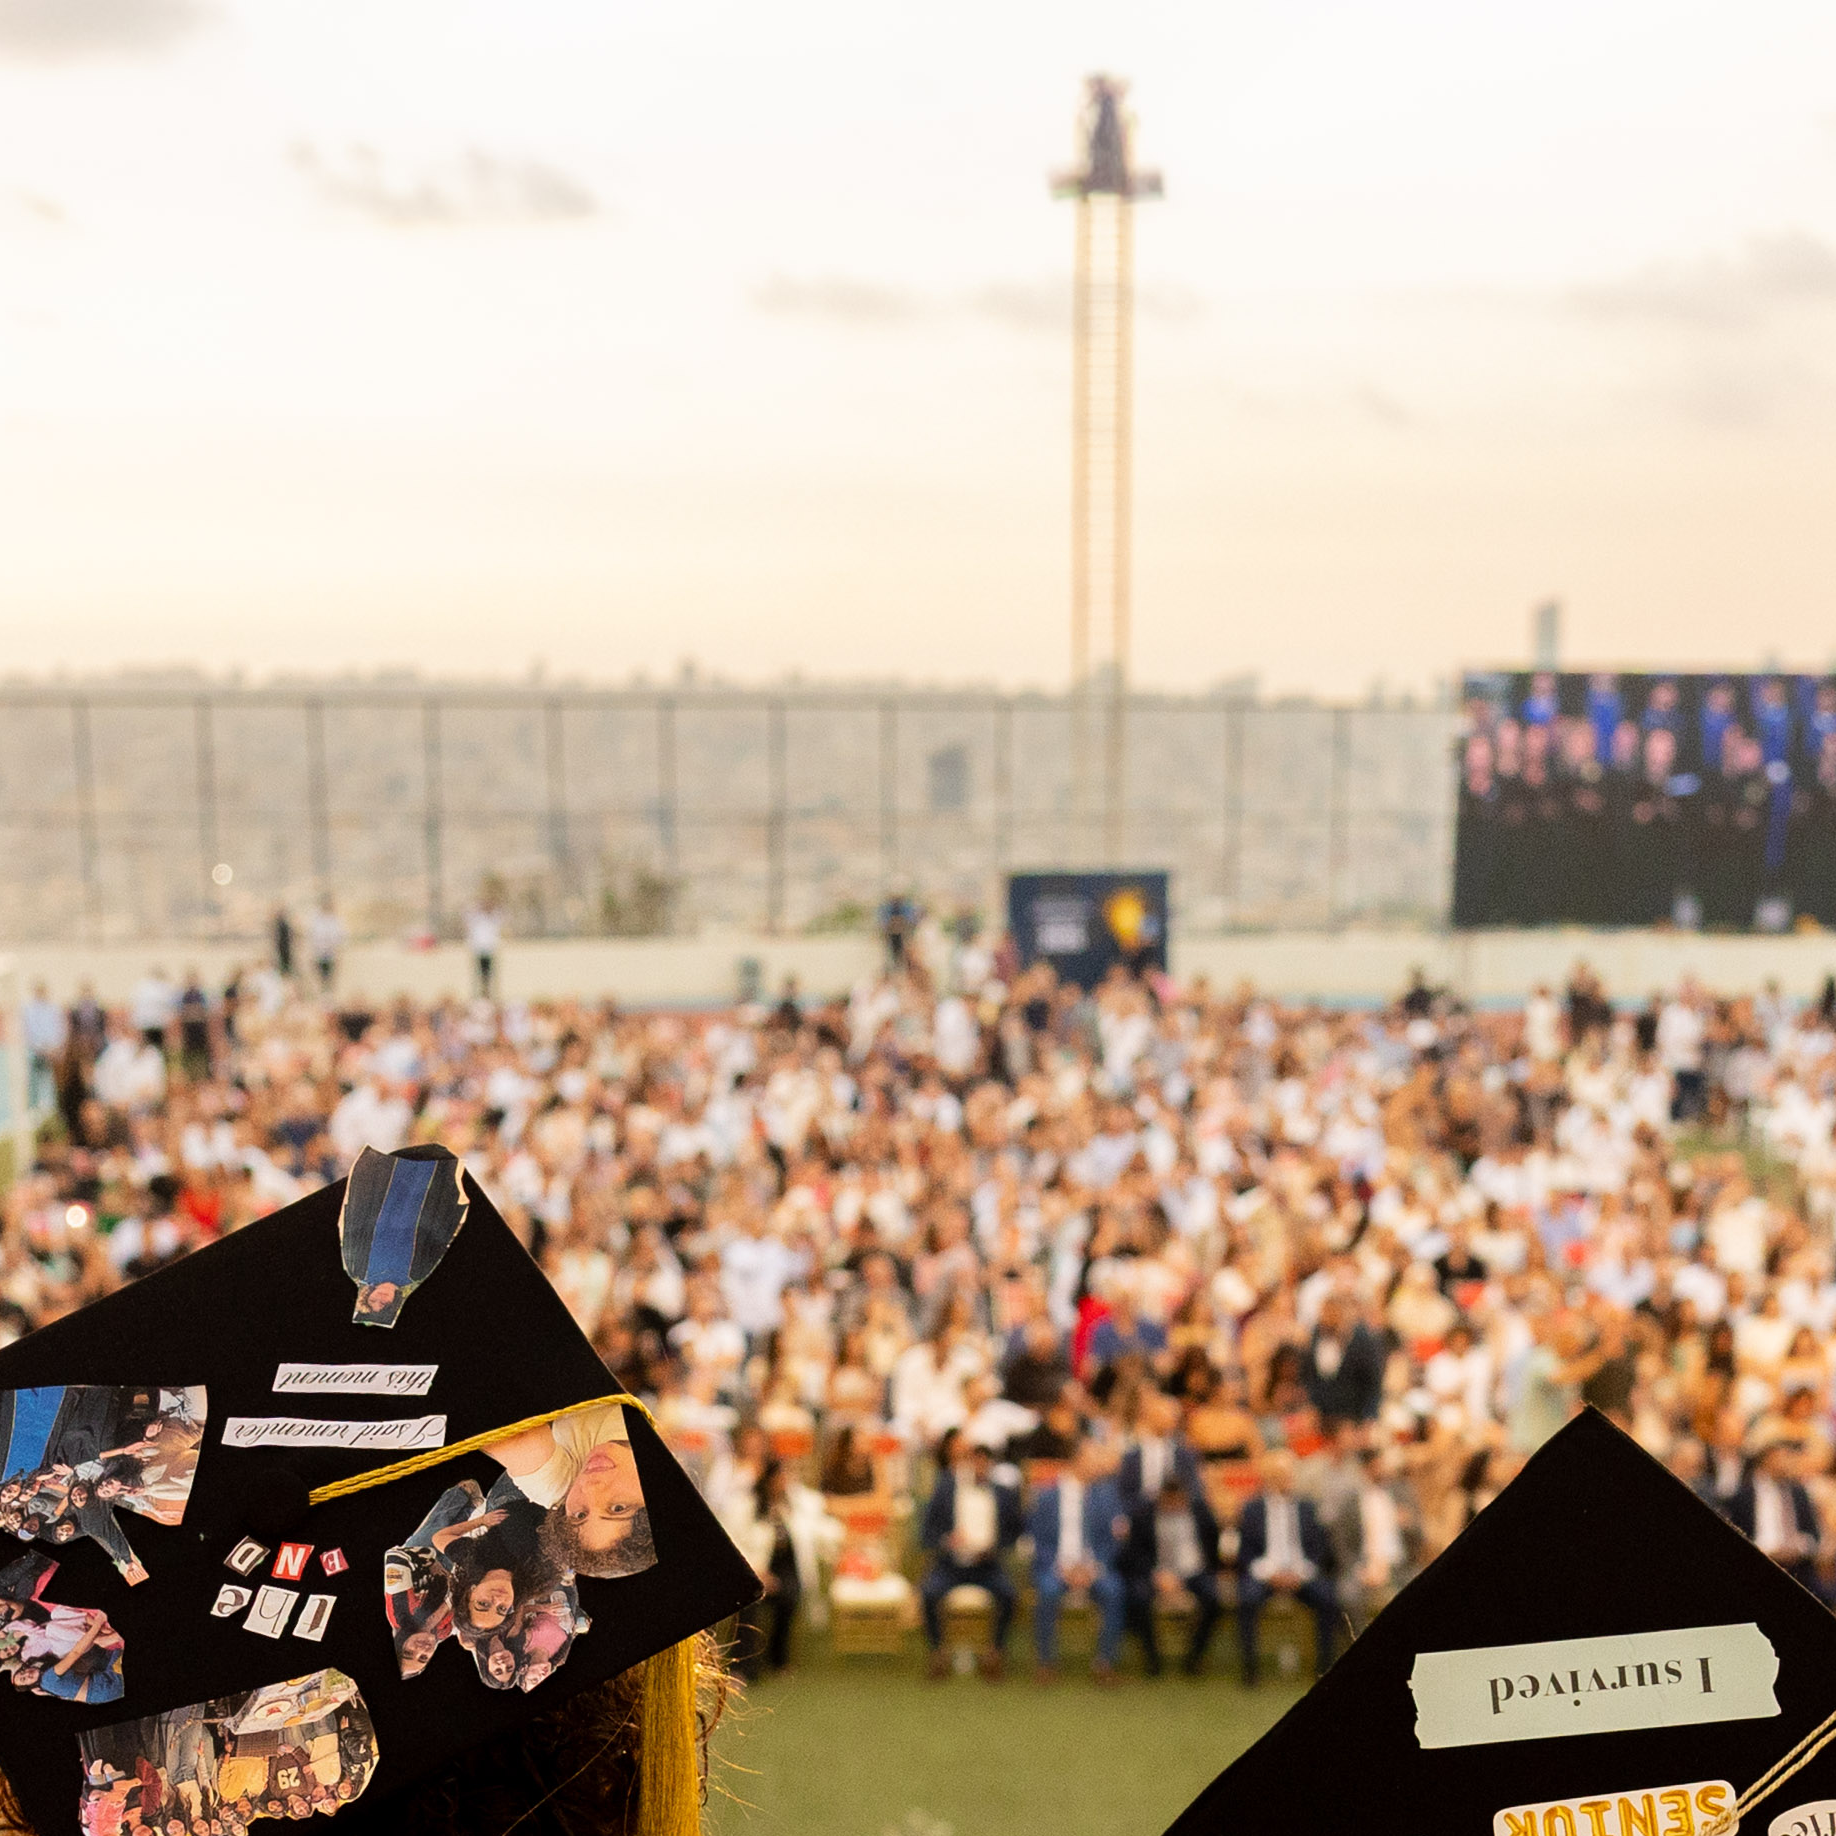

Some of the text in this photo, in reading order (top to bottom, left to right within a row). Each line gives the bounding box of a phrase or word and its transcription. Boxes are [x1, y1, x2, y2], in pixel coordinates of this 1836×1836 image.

[278, 1369, 433, 1393] this moment
[233, 1416, 445, 1449] I said remember
[230, 1541, 344, 1577] END
[216, 1588, 329, 1634] the
[1487, 1656, 1716, 1715] I survived
